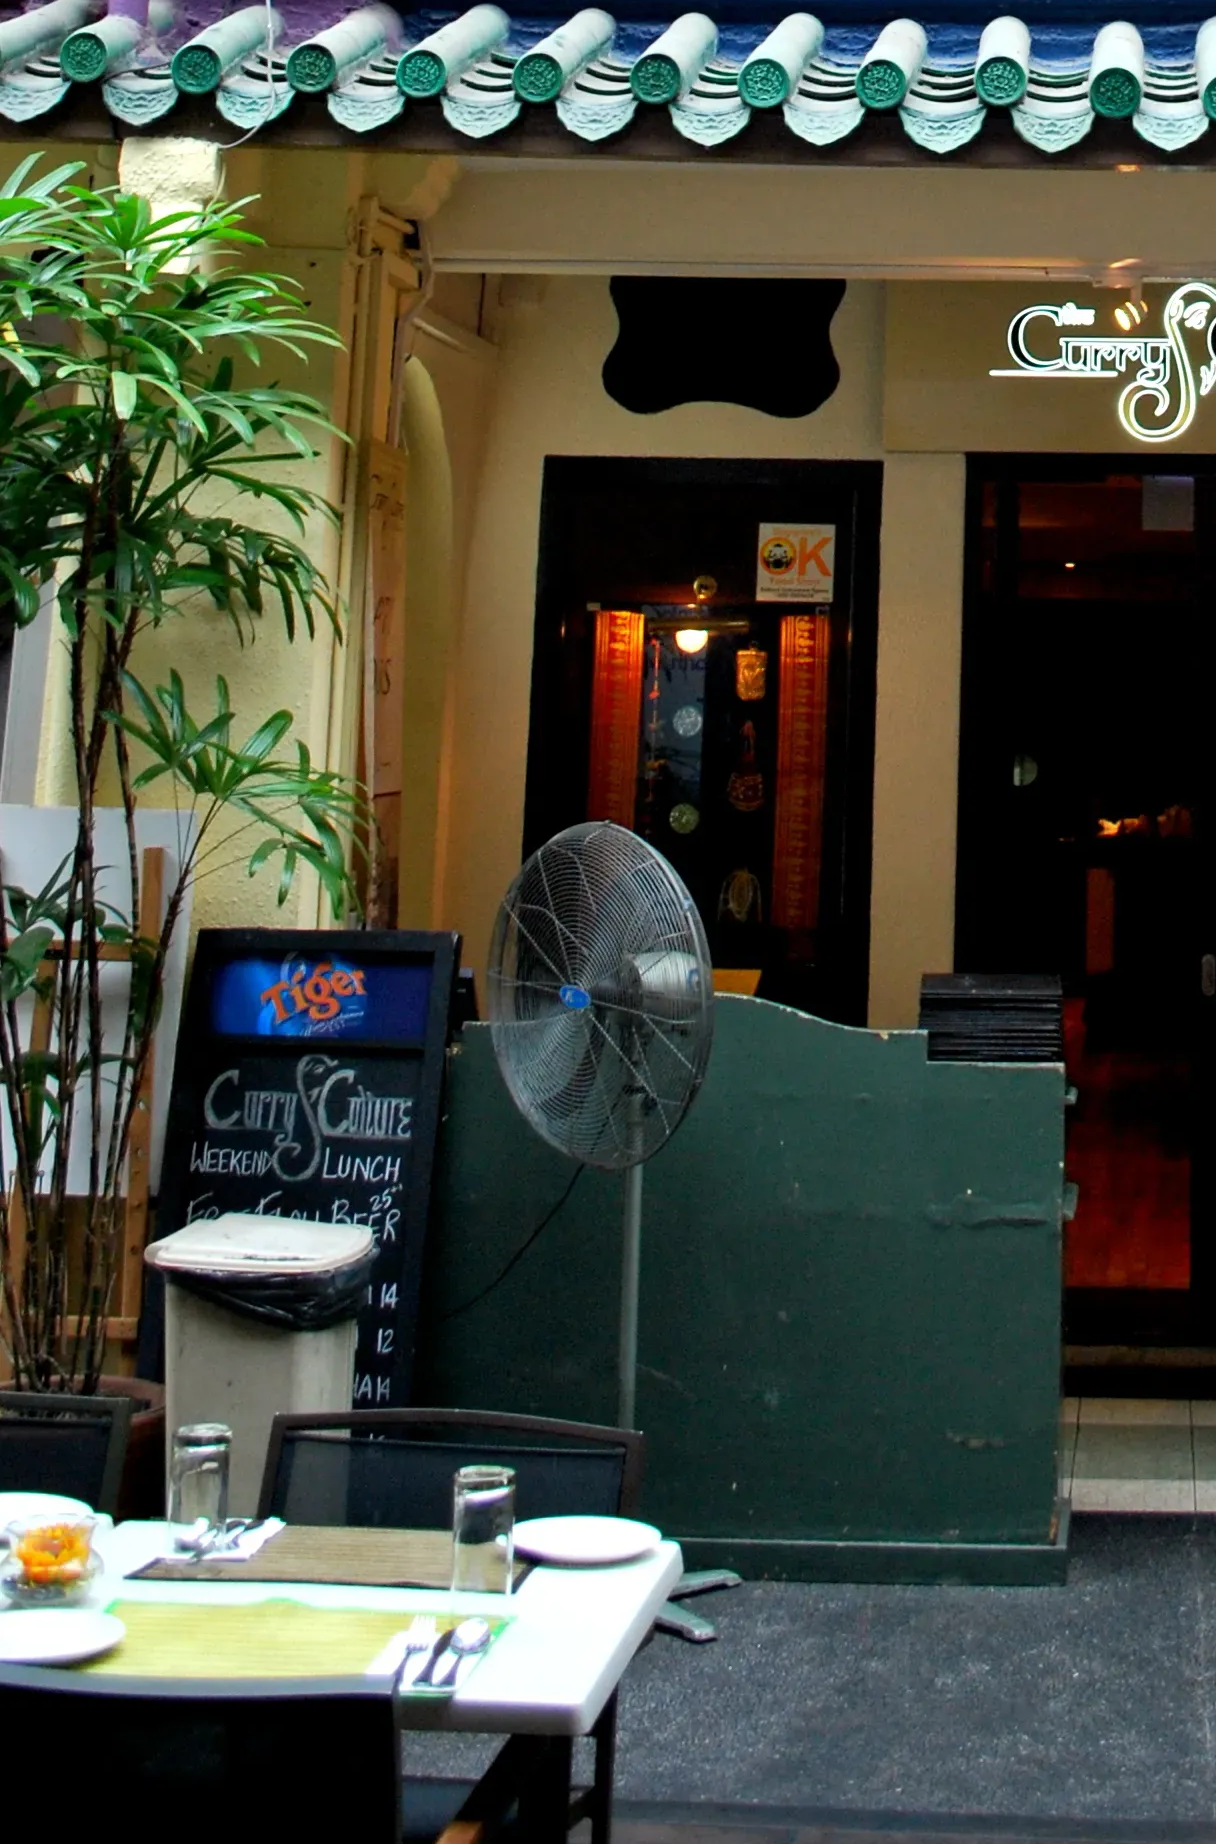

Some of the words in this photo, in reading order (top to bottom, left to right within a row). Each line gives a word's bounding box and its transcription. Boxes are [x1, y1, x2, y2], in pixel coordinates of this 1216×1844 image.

[1007, 304, 1172, 385] Curry
[760, 536, 833, 577] OK
[260, 961, 367, 1025] Tiger
[204, 1068, 299, 1145] Curry
[190, 1141, 275, 1177] WEEKEND
[321, 1146, 402, 1183] LUNCH
[380, 1282, 400, 1309] 14
[377, 1327, 394, 1354] 12
[376, 1375, 390, 1403] 14
